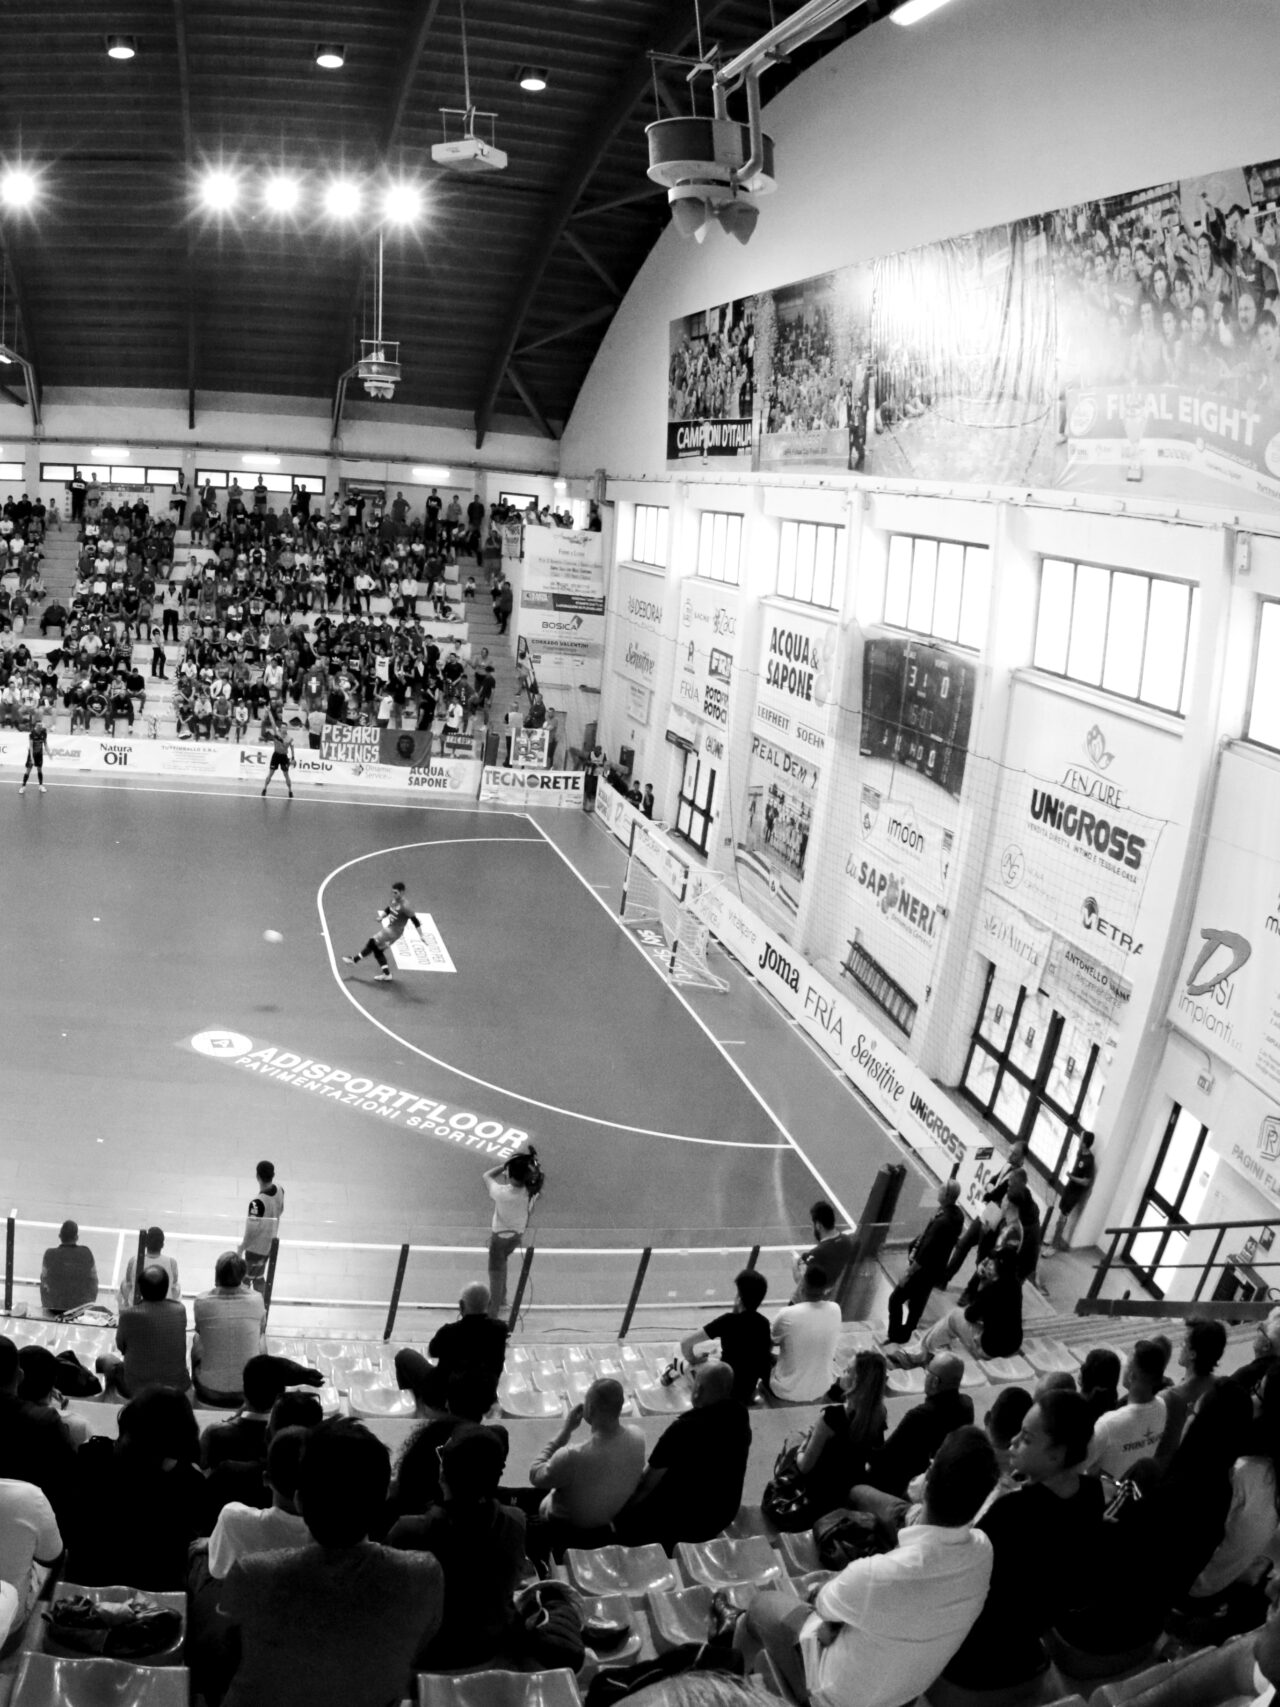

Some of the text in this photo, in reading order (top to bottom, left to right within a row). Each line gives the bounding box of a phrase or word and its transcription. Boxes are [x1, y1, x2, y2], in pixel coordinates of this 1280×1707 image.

[677, 424, 720, 449] CAMPONI
[1179, 396, 1261, 446] EIGHT
[769, 626, 810, 666] ACQUA
[766, 658, 814, 702] SAPONE
[321, 723, 381, 746] PESARO
[757, 704, 791, 731] LEIFHEIT
[99, 742, 133, 753] Natura
[103, 752, 128, 766] Oil
[320, 741, 381, 764] VIKINGS
[752, 735, 780, 769] REAL
[408, 776, 448, 789] SAPONE
[409, 765, 444, 778] ACQUA
[484, 768, 582, 791] TECNORETE
[1061, 767, 1124, 810] SENSURE
[757, 940, 802, 995] Joma
[1176, 988, 1236, 1045] impianti
[850, 1032, 906, 1103] Sensitive
[234, 1056, 519, 1160] PAVIMENTAZIONI SPORTIVE
[247, 1046, 530, 1150] ADISPORTFLOOR
[1231, 1143, 1265, 1182] PAGINI
